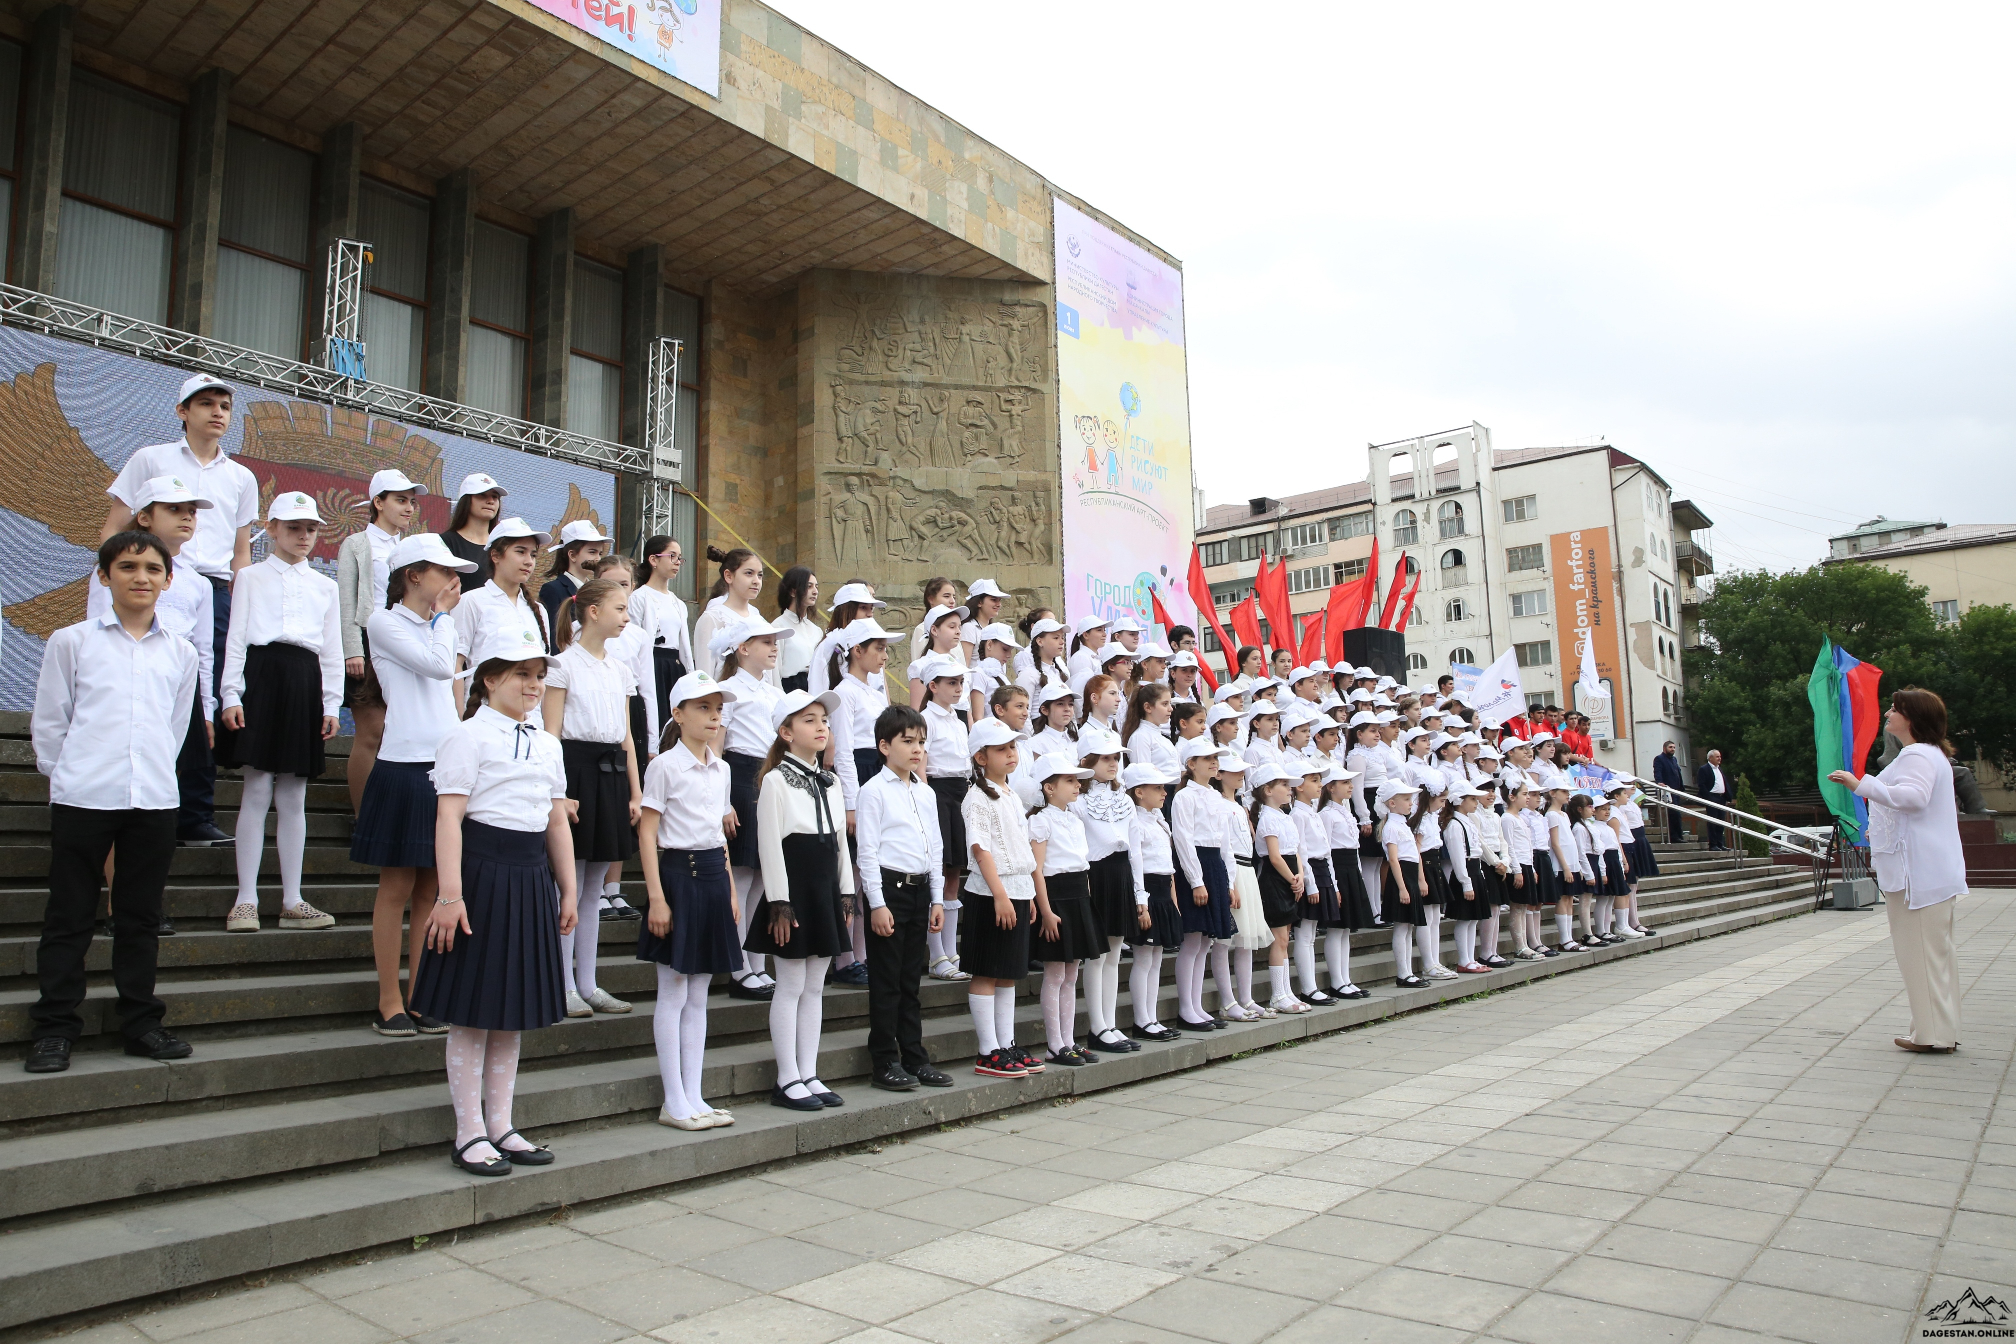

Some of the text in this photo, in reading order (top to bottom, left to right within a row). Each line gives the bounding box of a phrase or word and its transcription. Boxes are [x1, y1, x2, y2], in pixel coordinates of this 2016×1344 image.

[1066, 311, 1071, 325] 1
[1129, 434, 1155, 457] ДЕТИ
[1131, 454, 1169, 482] РИСУЮТ
[1132, 475, 1154, 496] МИР
[1079, 497, 1136, 513] РЕСПУБЛИКАНСКИЙ
[1086, 573, 1134, 611] ГОРОД
